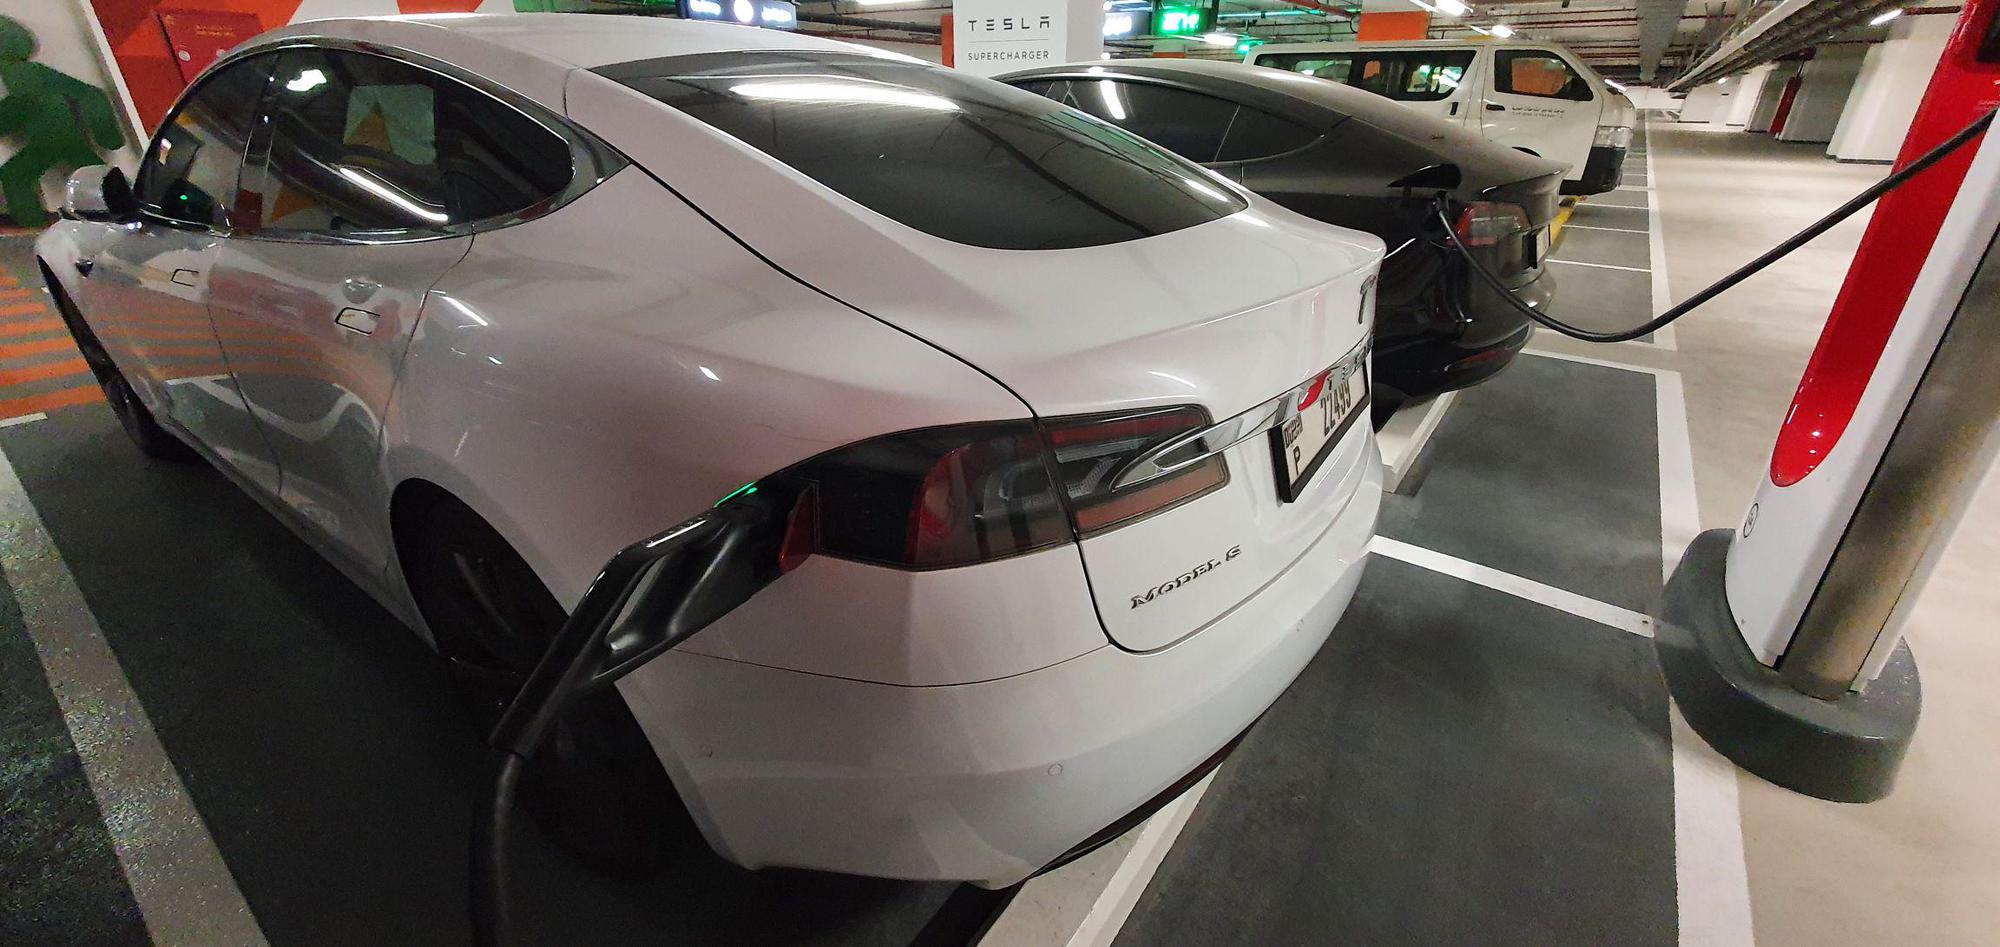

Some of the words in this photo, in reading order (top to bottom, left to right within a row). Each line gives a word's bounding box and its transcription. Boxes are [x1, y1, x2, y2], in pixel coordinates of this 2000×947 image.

[967, 15, 1050, 32] TESLA
[968, 50, 1049, 61] SUPERCHARGER
[1293, 446, 1301, 476] P
[1130, 558, 1222, 610] MODEL
